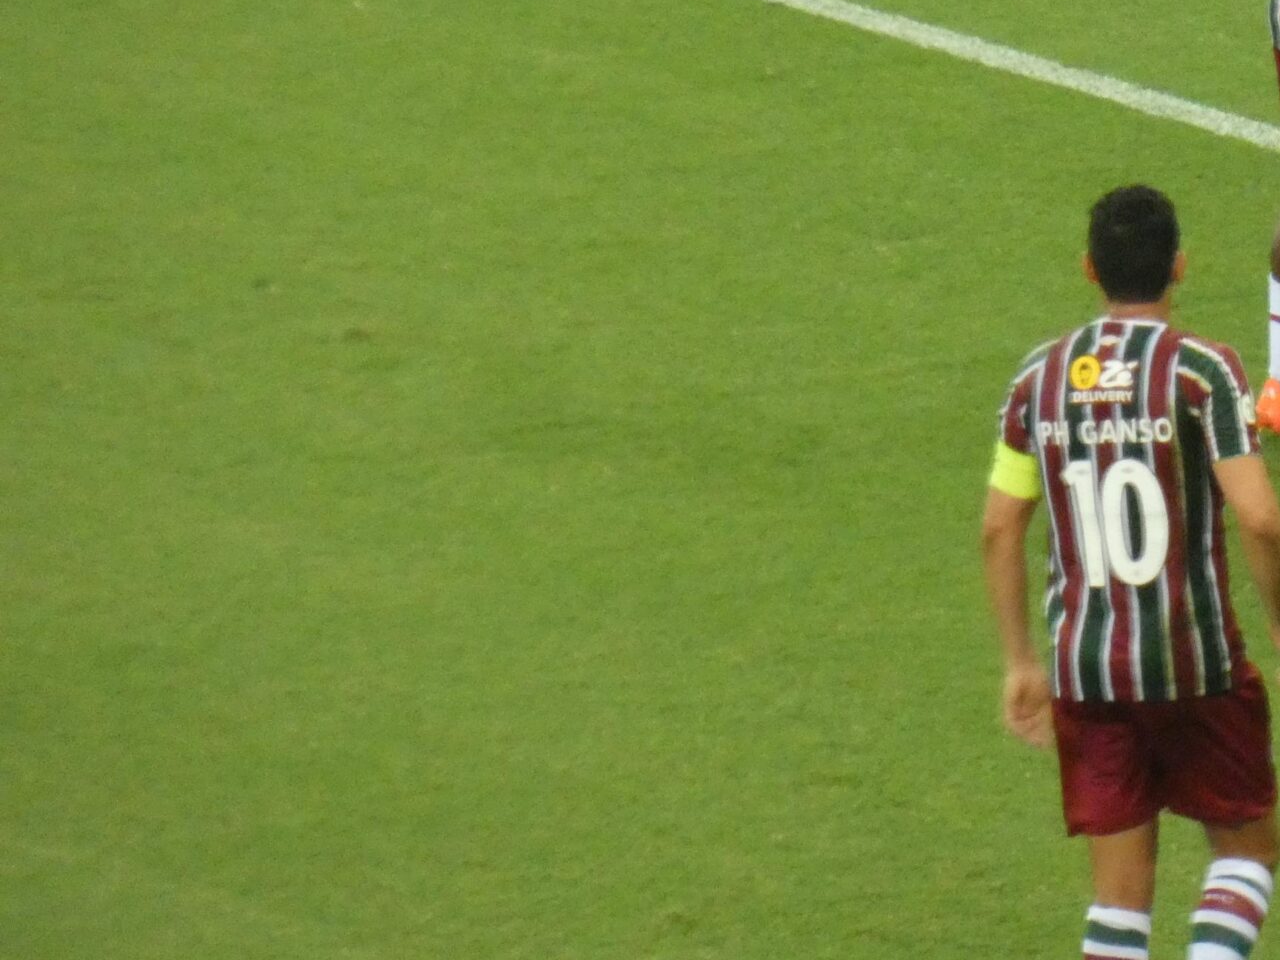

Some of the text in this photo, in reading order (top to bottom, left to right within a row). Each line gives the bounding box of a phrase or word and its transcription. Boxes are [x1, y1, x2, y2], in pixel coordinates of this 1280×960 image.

[1070, 390, 1133, 404] DELIVERY
[1039, 417, 1173, 446] PH GANSO
[1060, 458, 1169, 588] 10
